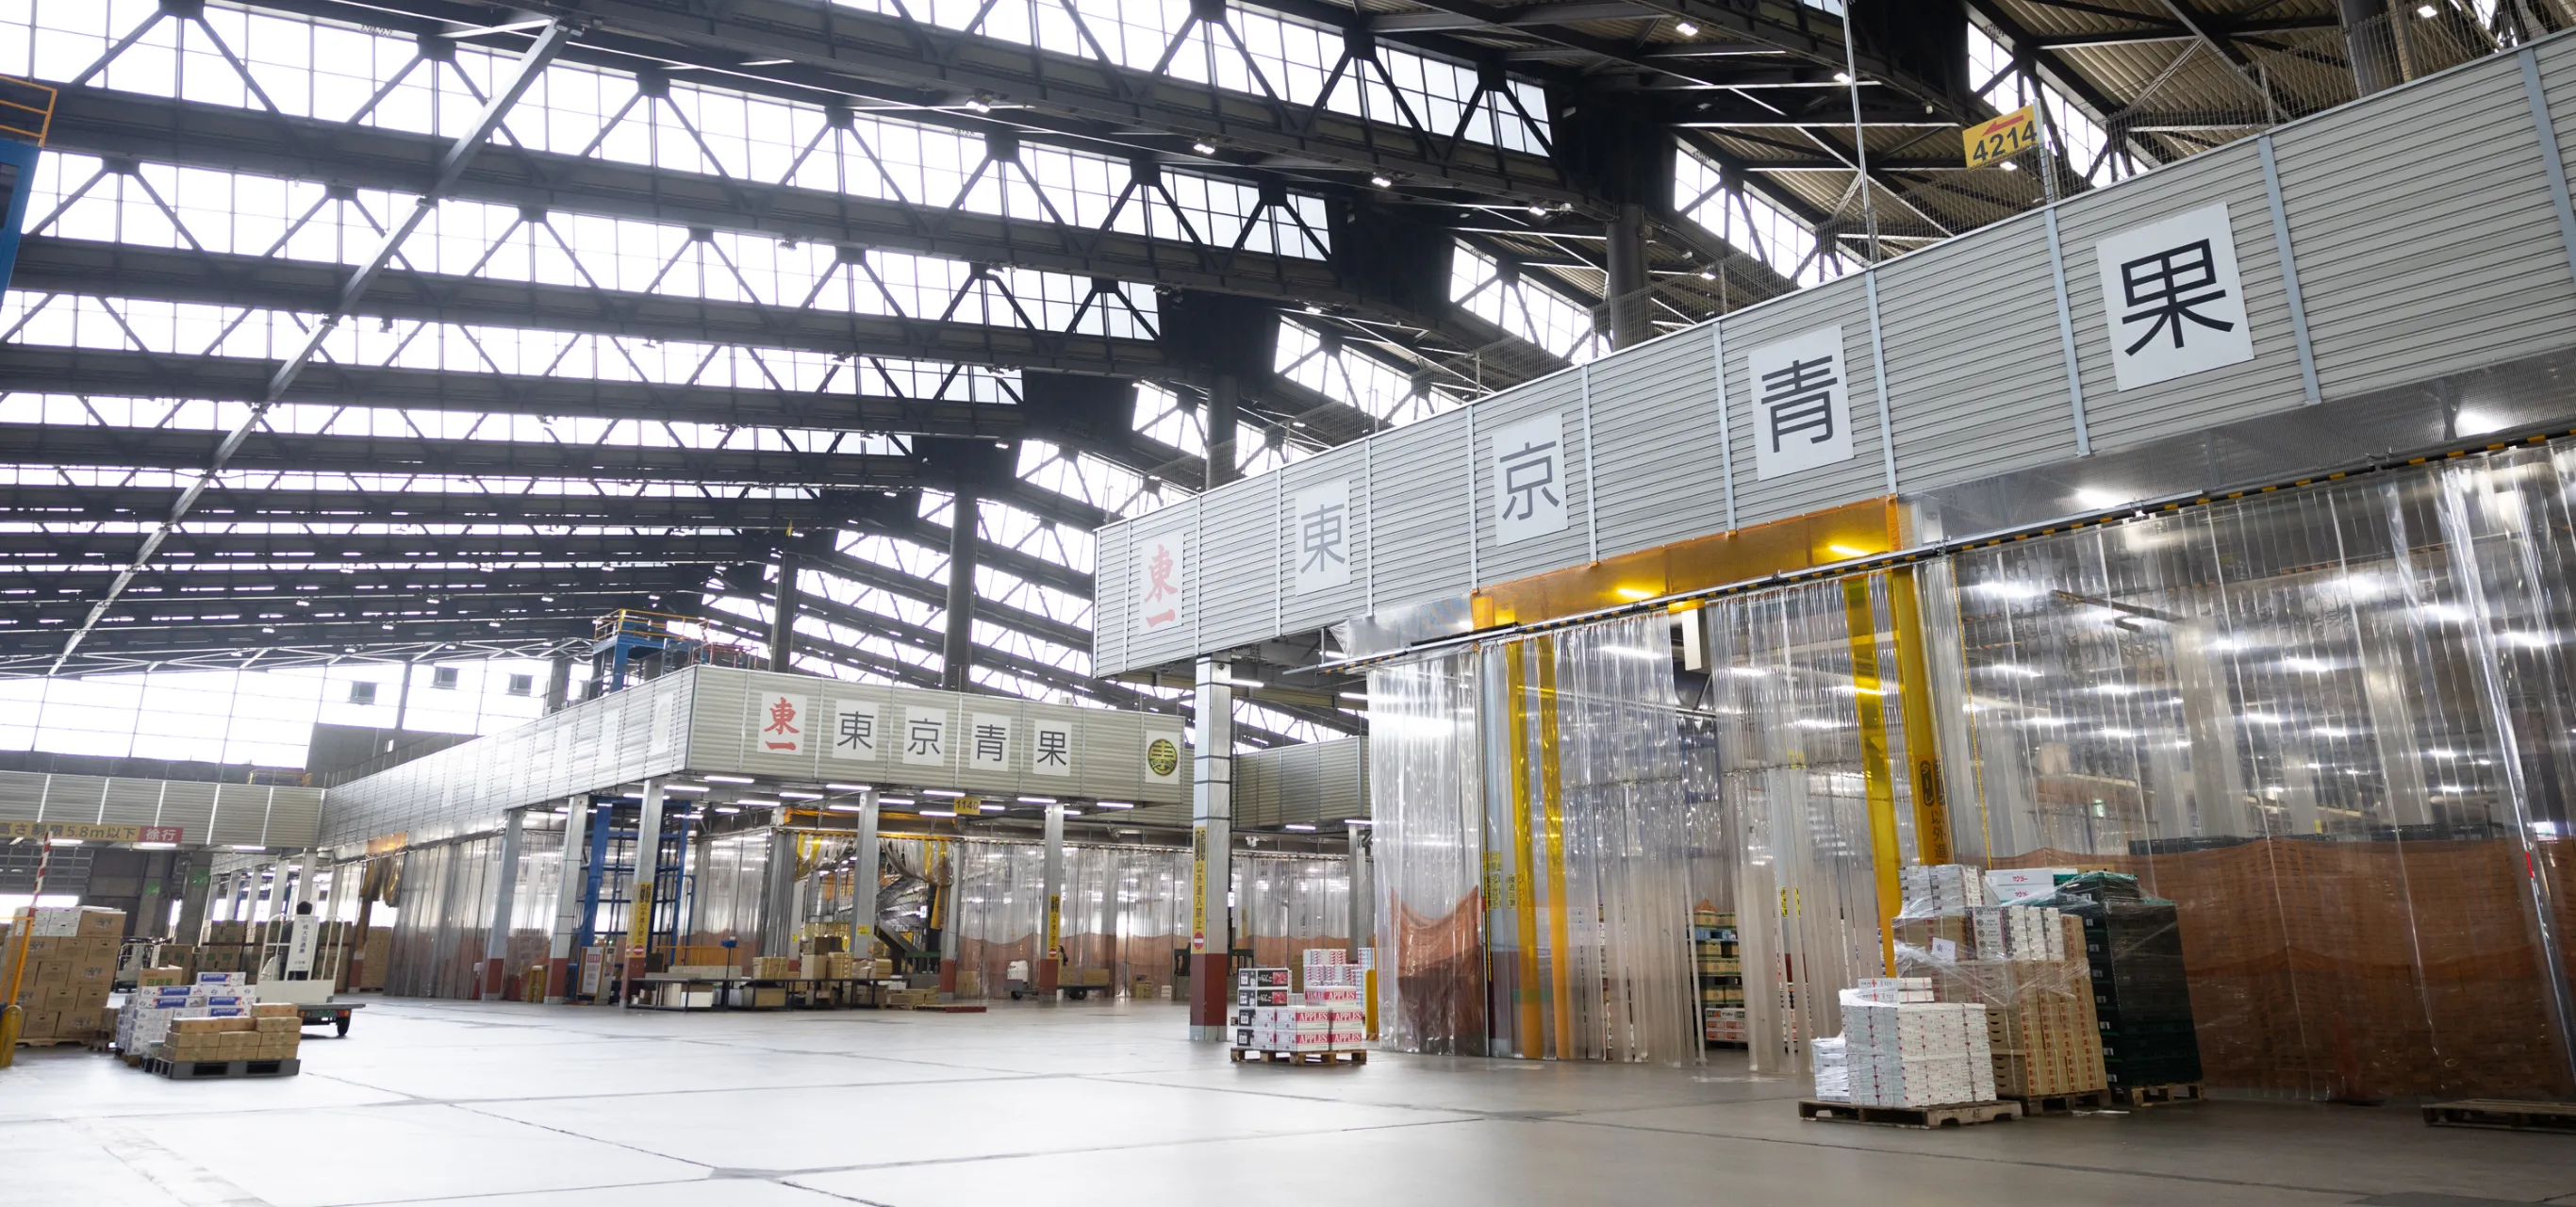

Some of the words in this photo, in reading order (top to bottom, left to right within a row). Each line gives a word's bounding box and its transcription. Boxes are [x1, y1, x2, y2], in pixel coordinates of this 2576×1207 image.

[1973, 120, 2038, 161] 4214
[1143, 543, 1178, 628] 東一
[764, 696, 801, 752] 東一
[835, 710, 1067, 767] 東京青果
[956, 799, 979, 811] 1140
[145, 828, 177, 842] 徐行
[1930, 810, 1948, 865] 以外進
[1329, 990, 1355, 1000] APPLES
[1300, 1012, 1329, 1022] APPLES
[1335, 1011, 1362, 1021] APPLES
[1300, 1033, 1329, 1044] APPLES
[1334, 1033, 1362, 1043] APPLES
